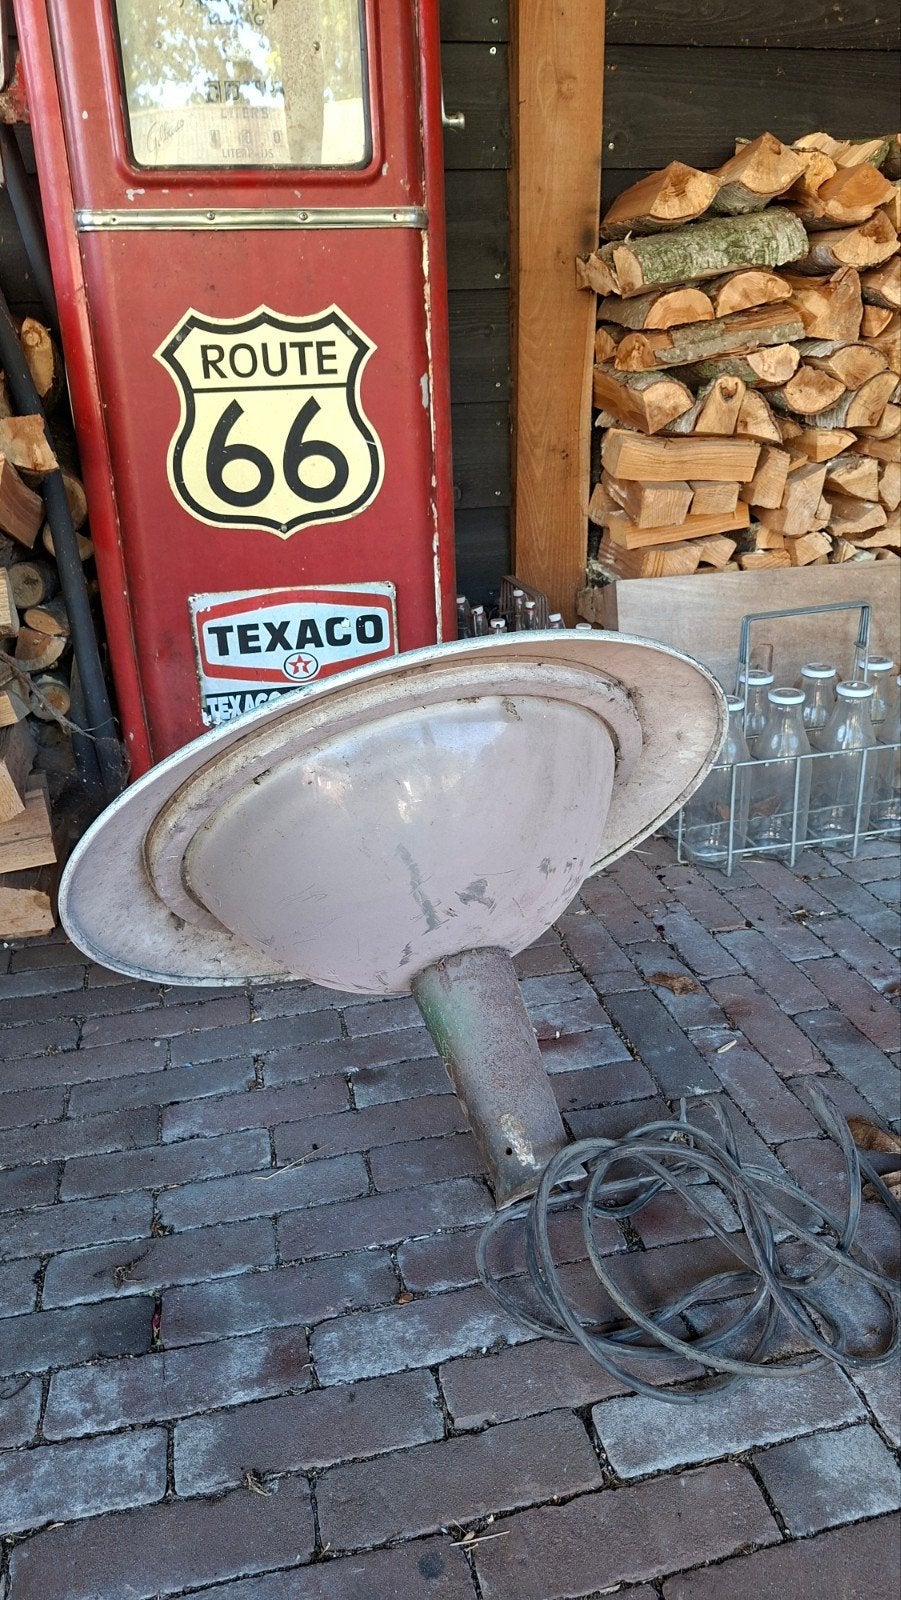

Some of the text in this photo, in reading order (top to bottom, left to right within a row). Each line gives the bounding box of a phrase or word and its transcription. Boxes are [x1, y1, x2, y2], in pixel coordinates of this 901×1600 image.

[200, 340, 338, 380] ROUTE
[206, 395, 349, 508] 66
[208, 614, 383, 656] TEXACO
